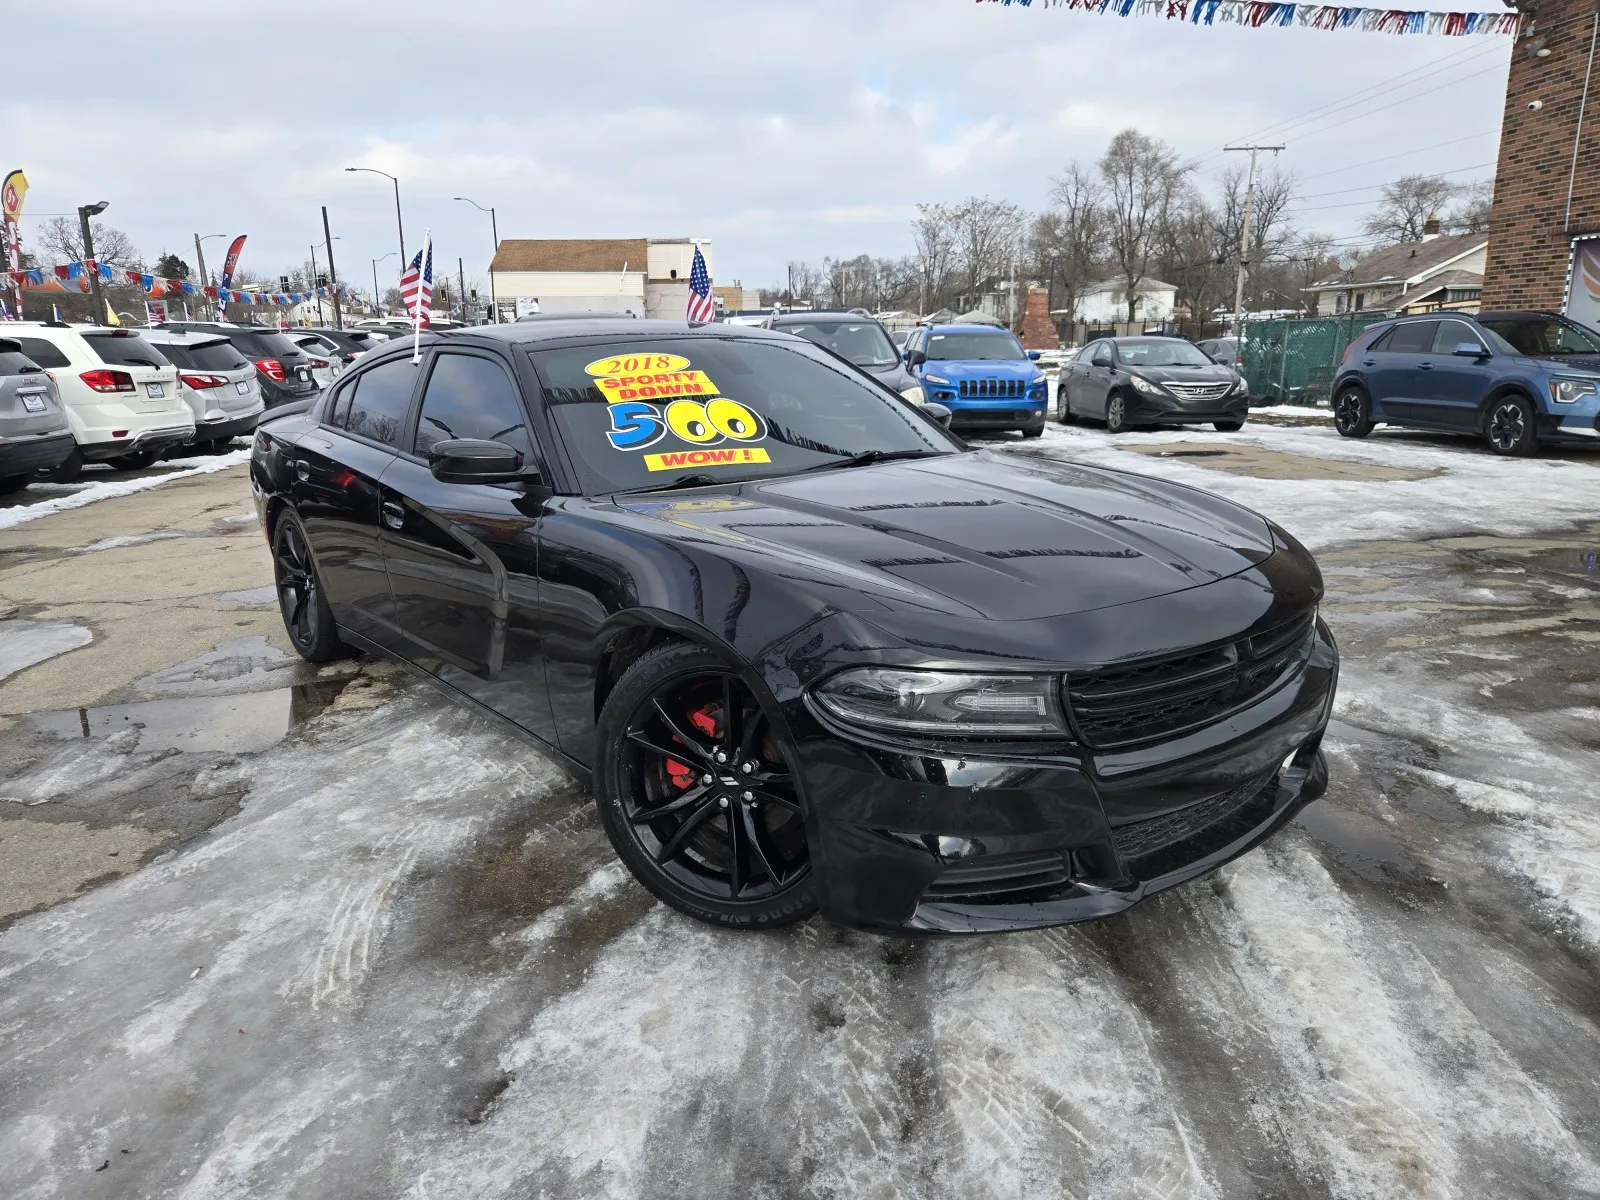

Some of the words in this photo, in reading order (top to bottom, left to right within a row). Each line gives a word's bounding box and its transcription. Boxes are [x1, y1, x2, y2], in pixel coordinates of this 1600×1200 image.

[607, 355, 671, 374] 2018
[604, 371, 697, 389] SPORTY
[619, 383, 705, 400] DOWN
[606, 397, 768, 451] 500
